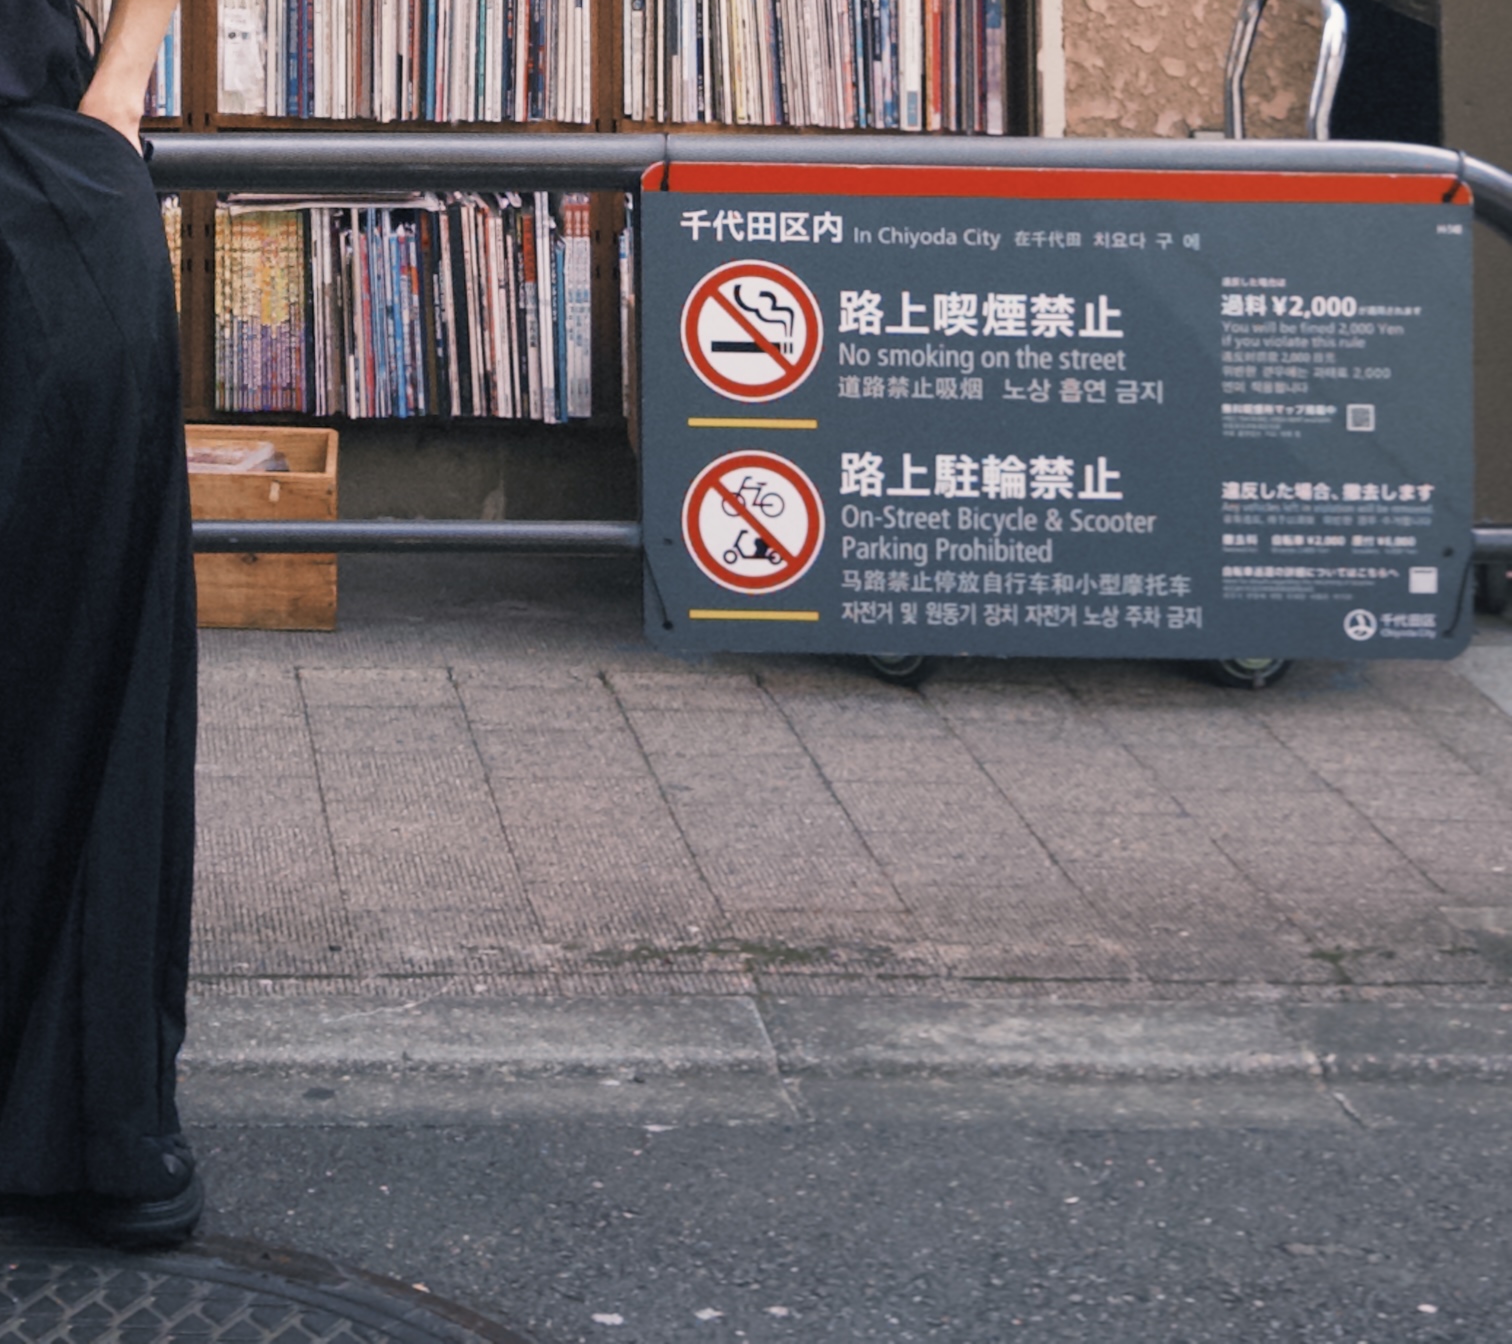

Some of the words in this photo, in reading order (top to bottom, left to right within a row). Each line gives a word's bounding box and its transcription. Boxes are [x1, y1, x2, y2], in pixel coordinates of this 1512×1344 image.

[680, 210, 844, 243] 千代田区内
[853, 228, 871, 245] In
[877, 227, 958, 249] Chiyoda
[963, 229, 1001, 250] City
[838, 290, 1125, 339] 路上喫煙禁止
[1221, 321, 1249, 334] You
[1252, 321, 1277, 334] will
[1279, 321, 1297, 334] be
[1300, 321, 1336, 335] fined
[1338, 322, 1375, 336] 2,000
[1377, 323, 1404, 335] Yen
[839, 342, 871, 367] No
[877, 342, 975, 374] smoking
[981, 349, 1009, 369] on
[1015, 345, 1053, 370] the
[1058, 348, 1127, 372] street
[1234, 337, 1260, 351] you
[1339, 336, 1366, 348] rule
[838, 376, 983, 400] 道路禁止吸烟
[1002, 378, 1051, 400] 노상
[1058, 379, 1107, 403] 흡연
[1114, 380, 1165, 404] 금지
[840, 452, 1124, 500] 路上駐輪禁止
[841, 504, 950, 531] On-Street
[958, 506, 1037, 537] Bicycle
[1044, 509, 1064, 532] &
[1070, 509, 1157, 534] Scooter
[842, 536, 928, 567] Parking
[936, 537, 1053, 563] Prohibited
[841, 601, 894, 625] 자전거
[1024, 605, 1078, 628] 자전거
[1083, 606, 1119, 629] 노상
[1166, 607, 1203, 630] 금지
[1380, 613, 1437, 628] 千代田区
